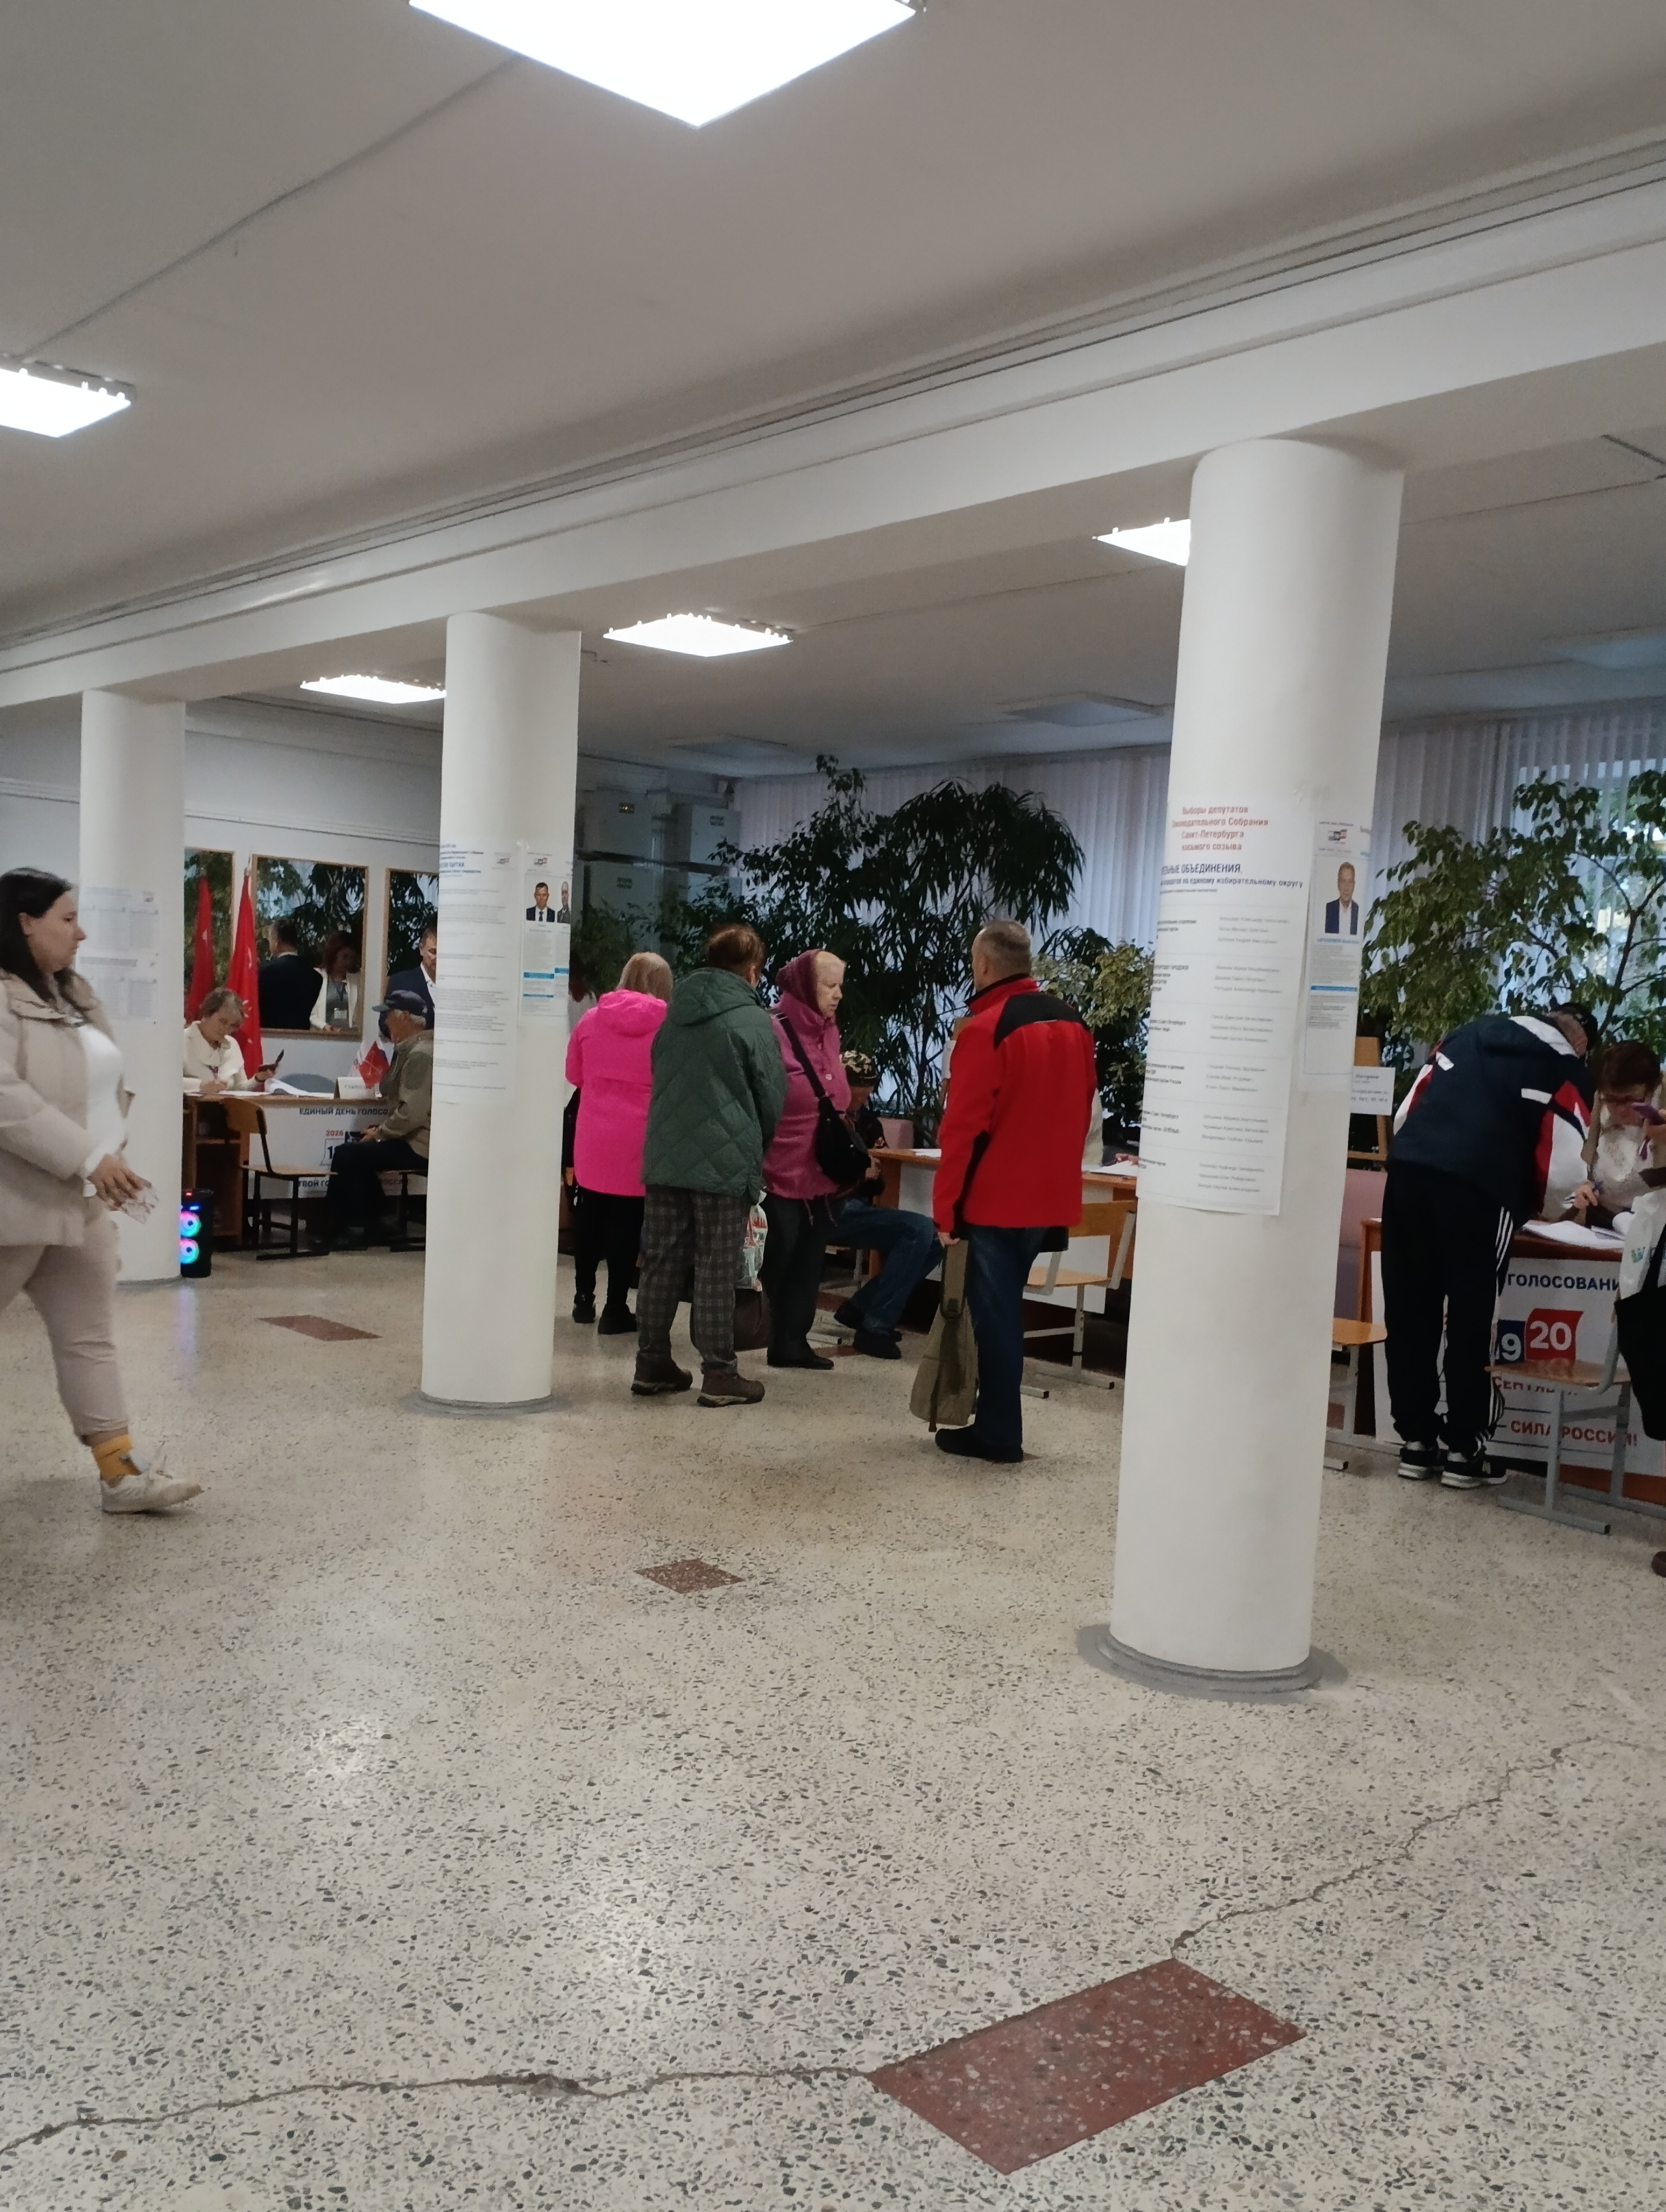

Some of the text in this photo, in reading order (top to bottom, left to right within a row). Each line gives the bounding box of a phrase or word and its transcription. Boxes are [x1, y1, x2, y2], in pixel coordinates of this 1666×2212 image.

[1228, 818, 1268, 827] Собрания
[1216, 877, 1276, 887] избирательному
[1279, 879, 1303, 889] округу
[299, 1107, 334, 1115] ЕДИНЫЙ
[1507, 1274, 1620, 1291] ГОЛОСОВАНИ
[1529, 1320, 1572, 1351] 20
